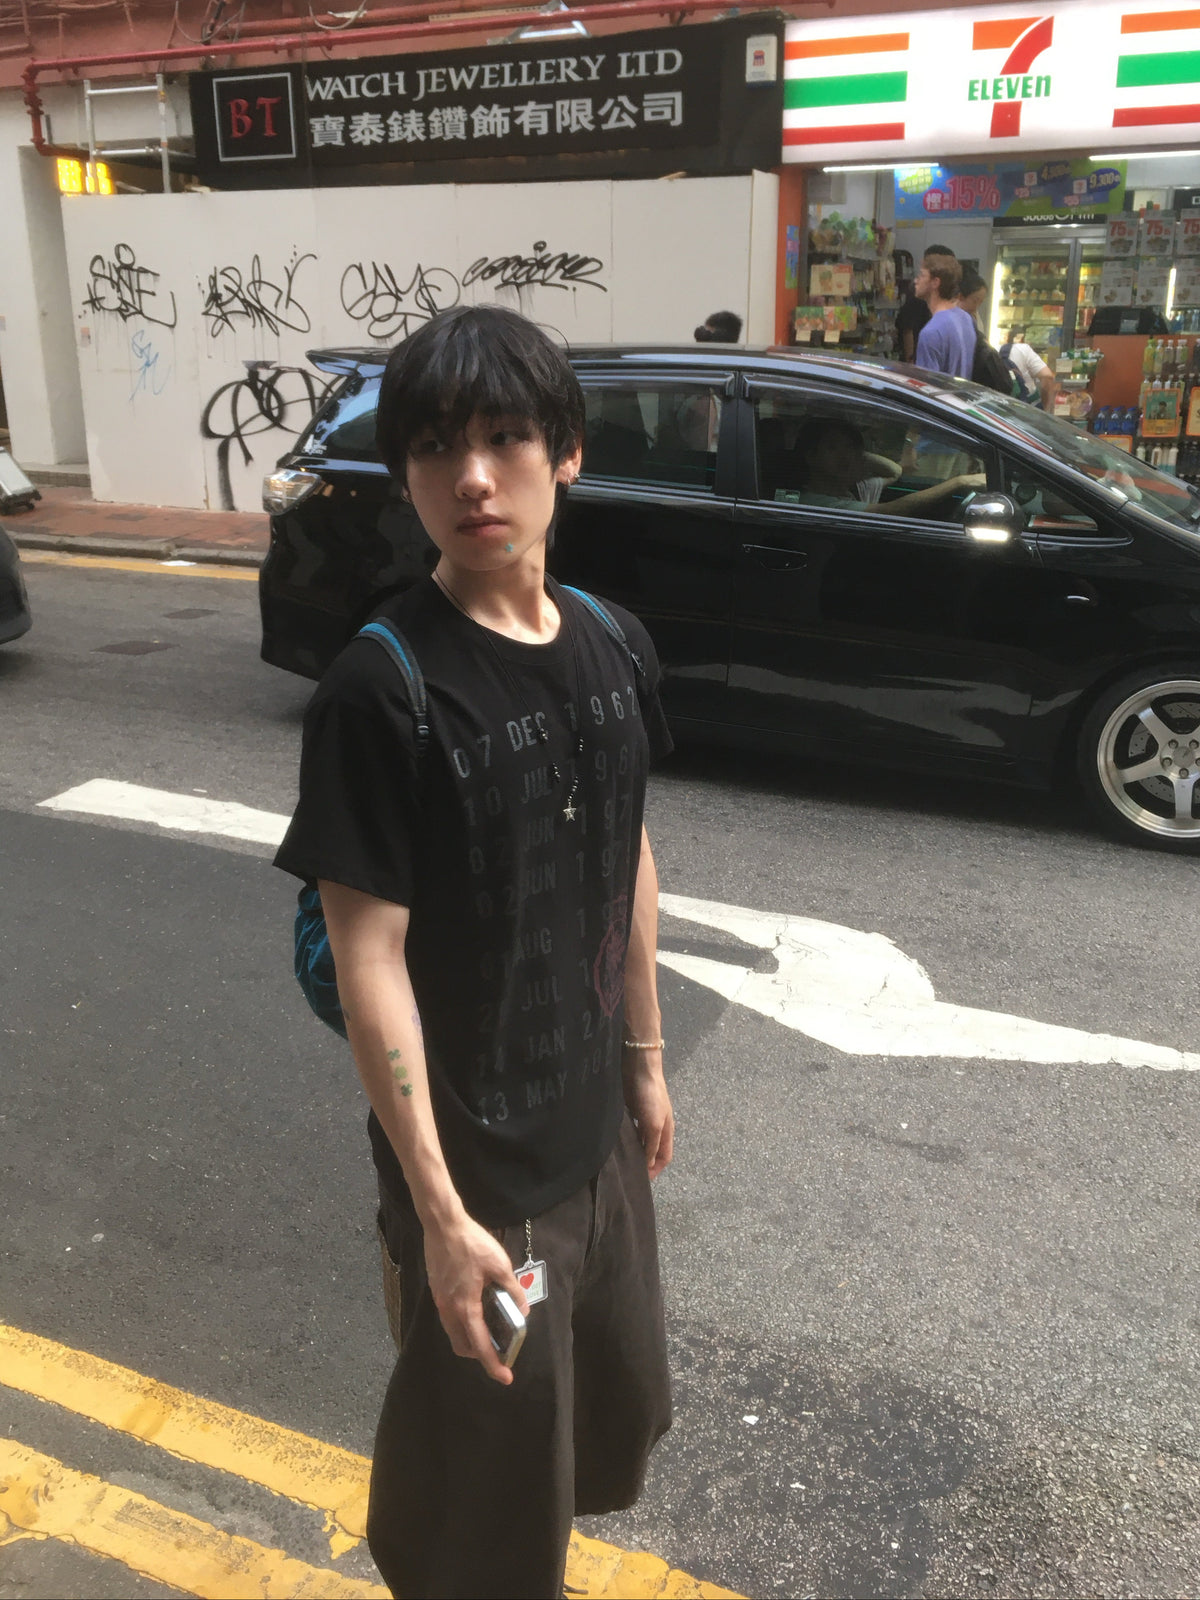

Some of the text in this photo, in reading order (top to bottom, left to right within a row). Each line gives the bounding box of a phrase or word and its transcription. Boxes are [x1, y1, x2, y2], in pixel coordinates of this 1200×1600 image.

[304, 48, 683, 101] WATCH JEWELLERY LTD
[228, 96, 281, 138] BT
[309, 91, 683, 147] 寶泰錶鑽飾有限公司
[946, 174, 1001, 211] 15%
[453, 734, 492, 779] 07
